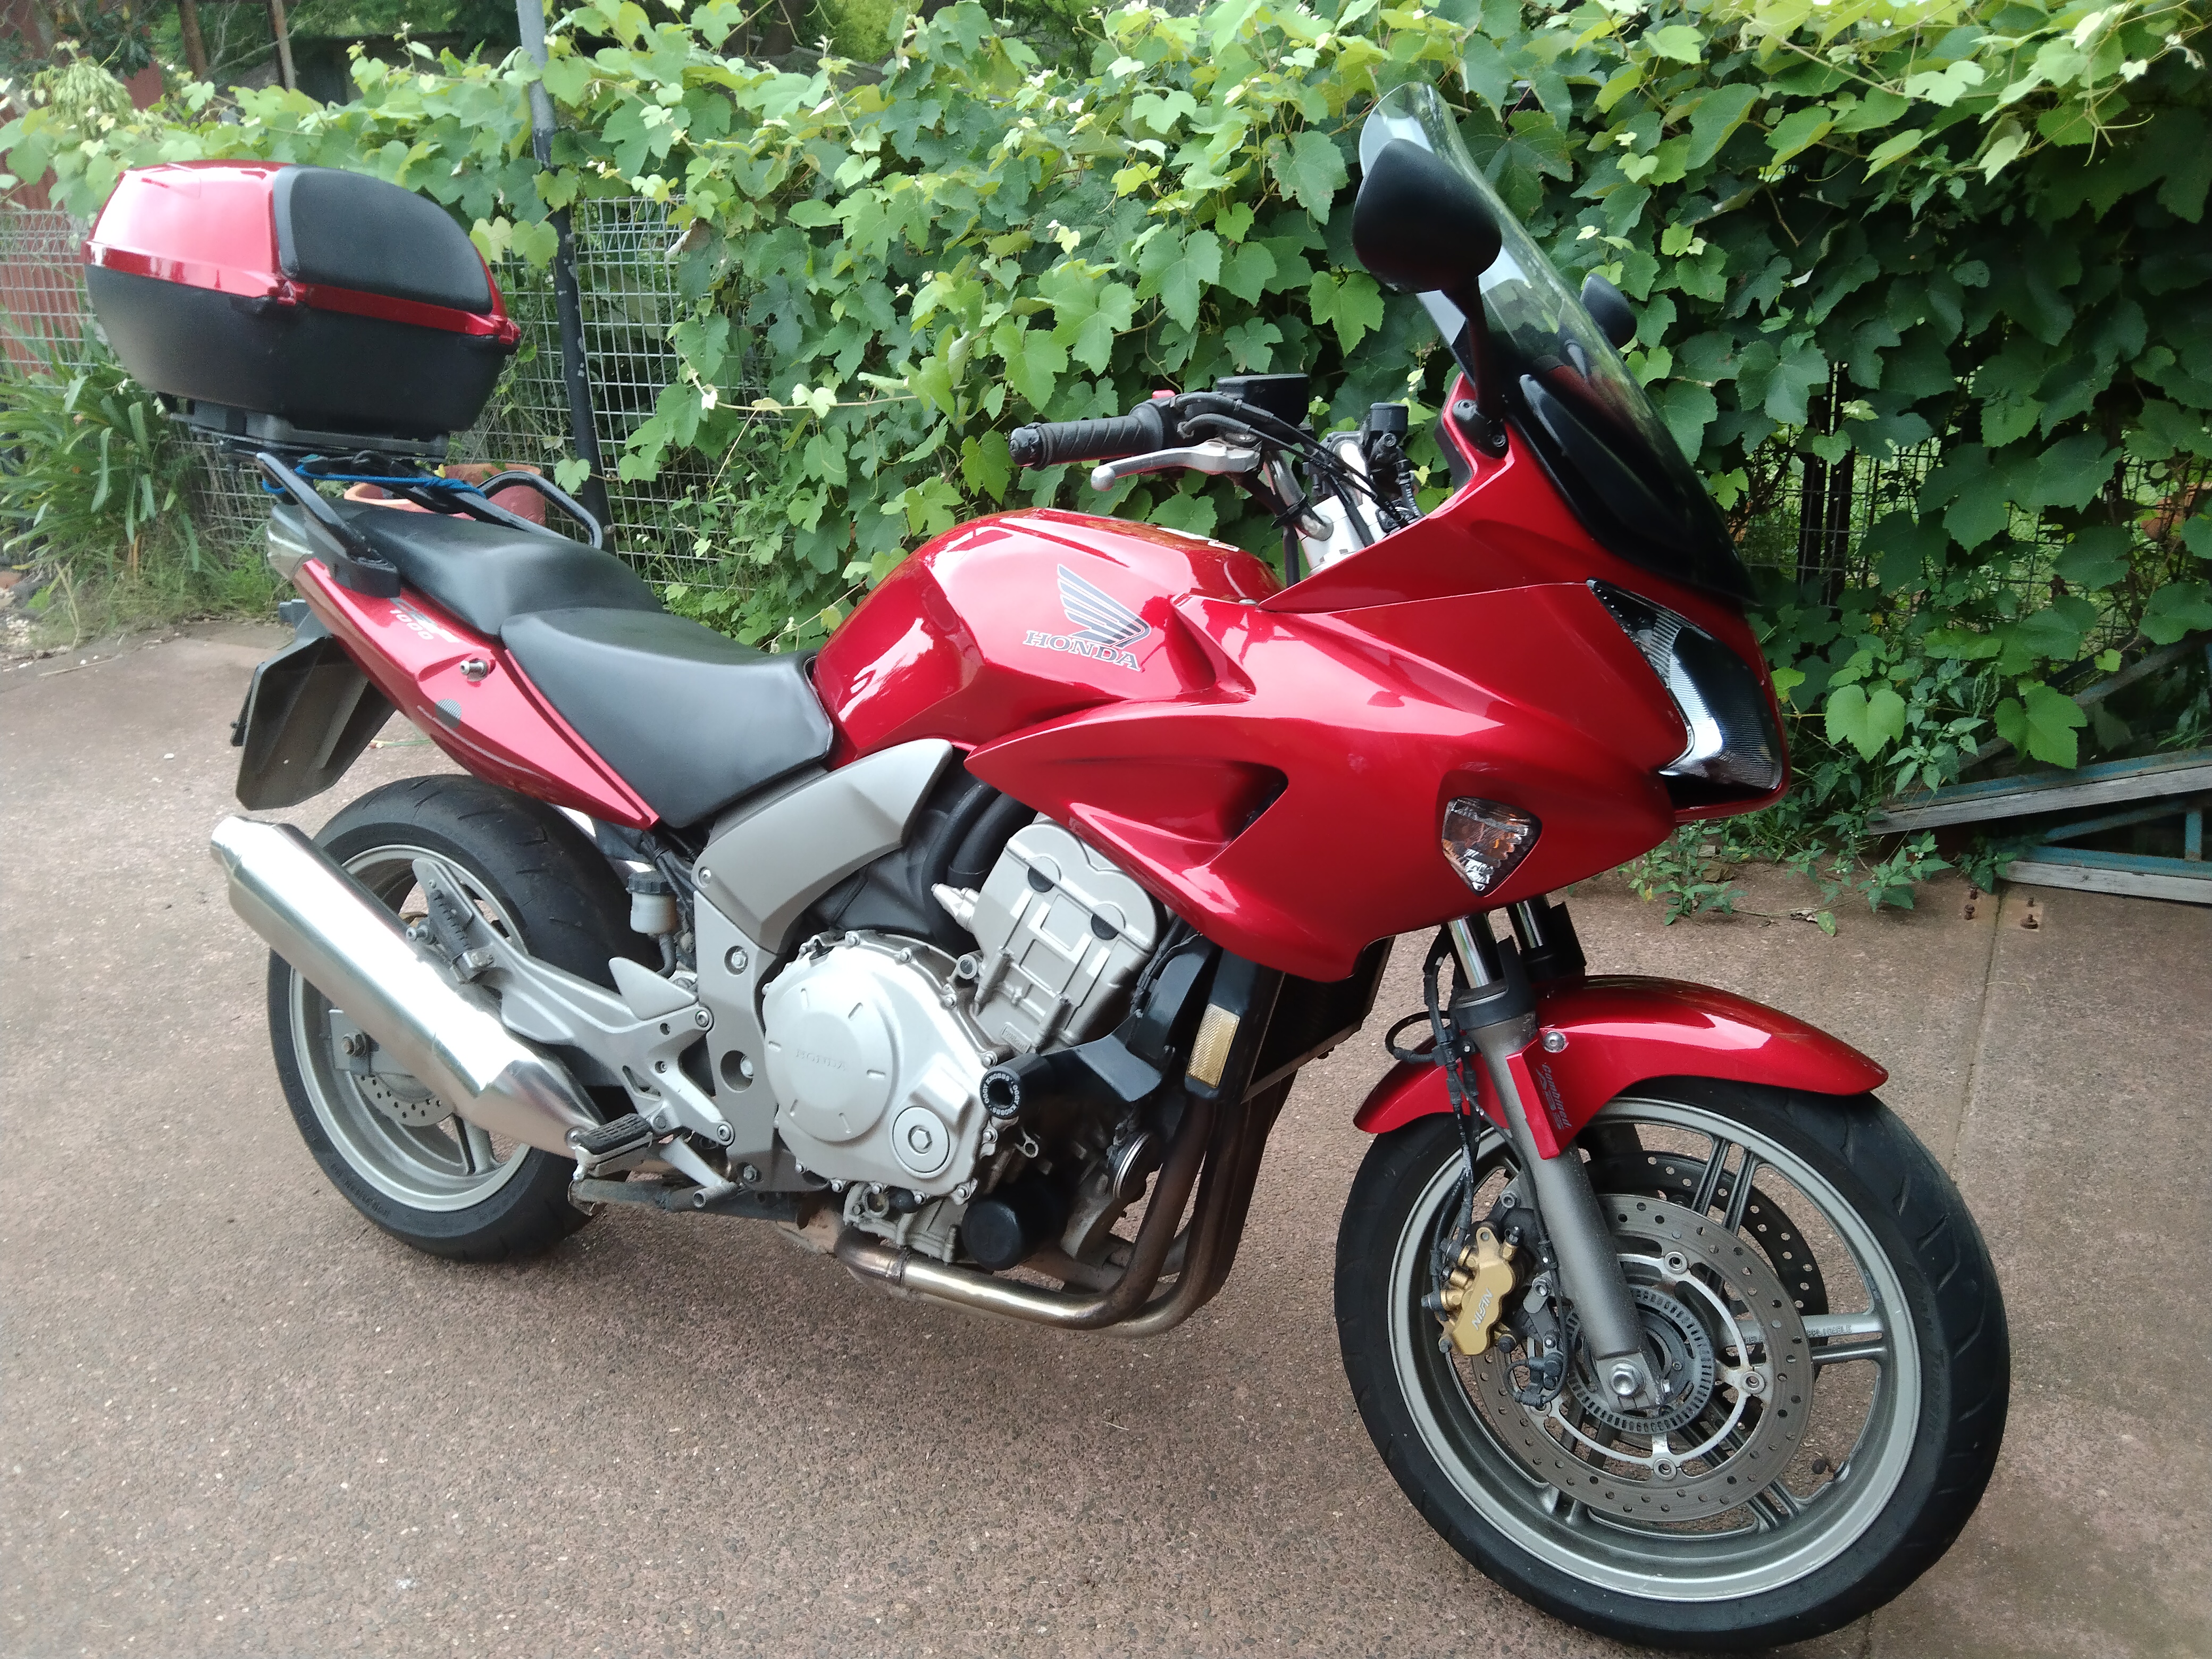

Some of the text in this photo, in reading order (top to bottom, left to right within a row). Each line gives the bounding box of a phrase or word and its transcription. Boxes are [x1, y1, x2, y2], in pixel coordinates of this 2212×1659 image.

[389, 609, 434, 640] 1000
[1022, 630, 1141, 672] HONDA
[795, 1049, 846, 1071] HONDA
[1807, 1325, 1852, 1338] PPLICABLE
